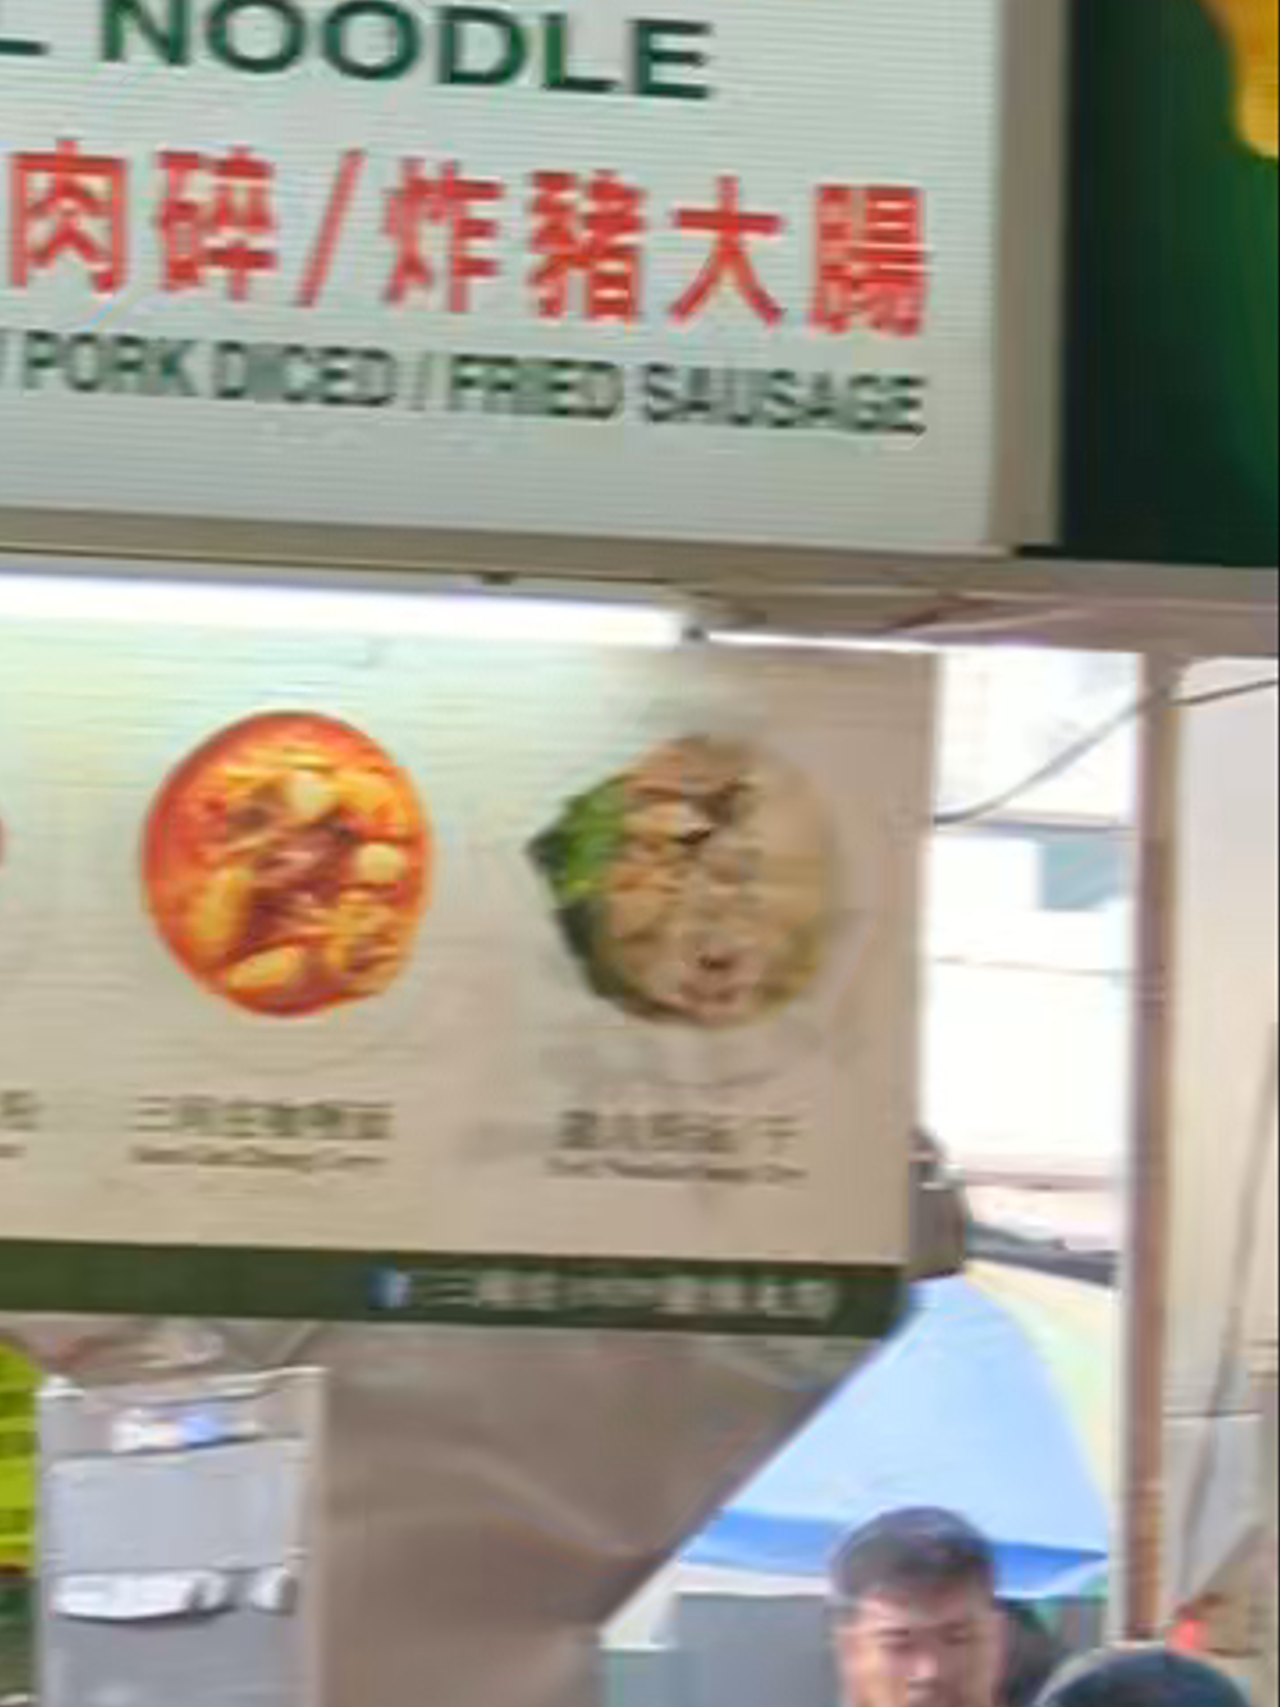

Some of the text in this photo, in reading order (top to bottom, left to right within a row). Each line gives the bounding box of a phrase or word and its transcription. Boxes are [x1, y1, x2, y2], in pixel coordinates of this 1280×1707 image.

[23, 328, 197, 397] PORK
[207, 339, 395, 407] DICED
[448, 353, 624, 421] FRIED
[643, 362, 928, 436] SAUSAGE
